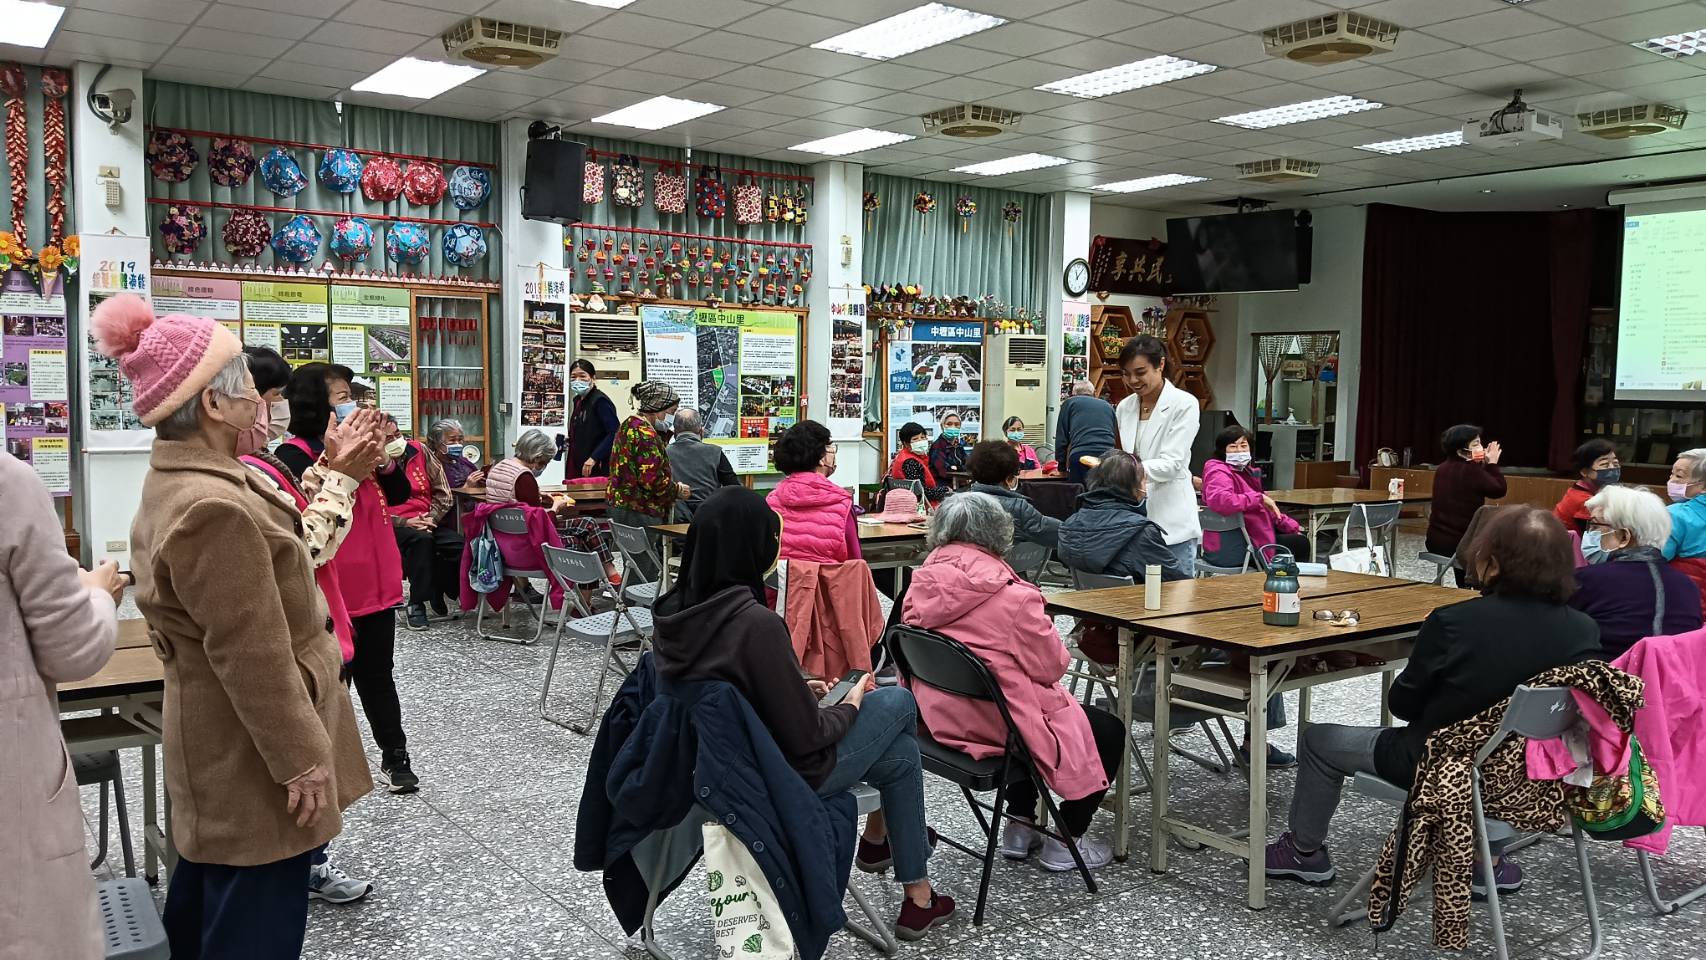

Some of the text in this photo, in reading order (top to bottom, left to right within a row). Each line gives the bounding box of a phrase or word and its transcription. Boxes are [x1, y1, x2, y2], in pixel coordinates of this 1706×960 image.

[99, 260, 136, 272] 2019
[930, 326, 981, 338] 中壢區中山里
[717, 914, 758, 927] DESERVES
[715, 927, 736, 938] BEST
